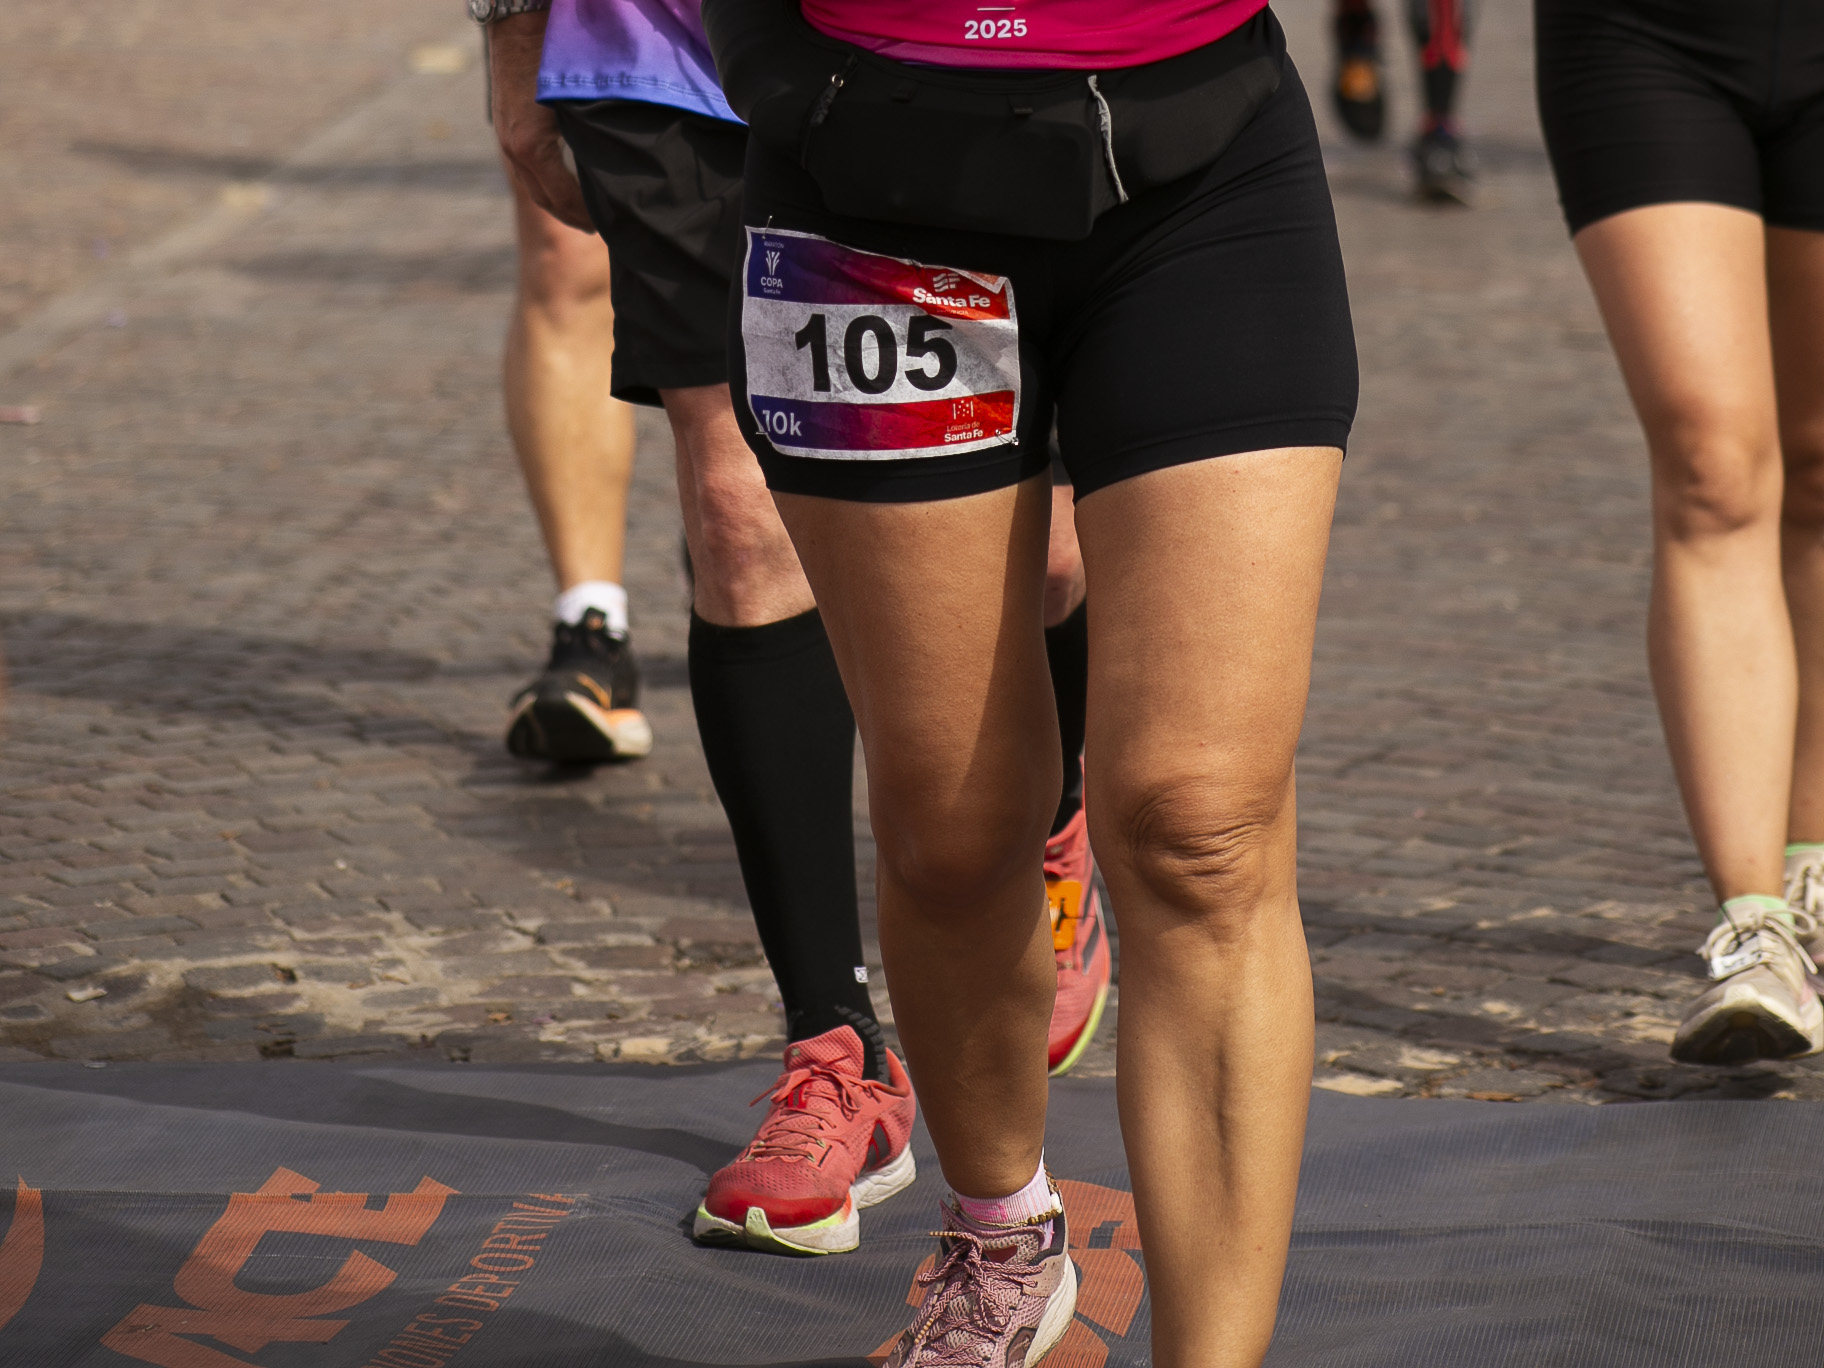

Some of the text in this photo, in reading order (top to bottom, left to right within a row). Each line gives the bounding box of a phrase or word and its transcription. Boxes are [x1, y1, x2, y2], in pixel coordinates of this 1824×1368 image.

[964, 18, 1028, 40] 2025
[760, 276, 784, 288] COPA
[912, 287, 991, 308] Santa Fe
[795, 313, 958, 395] 105
[762, 409, 802, 436] 10k
[971, 420, 981, 429] de
[944, 428, 984, 443] Santa Fe
